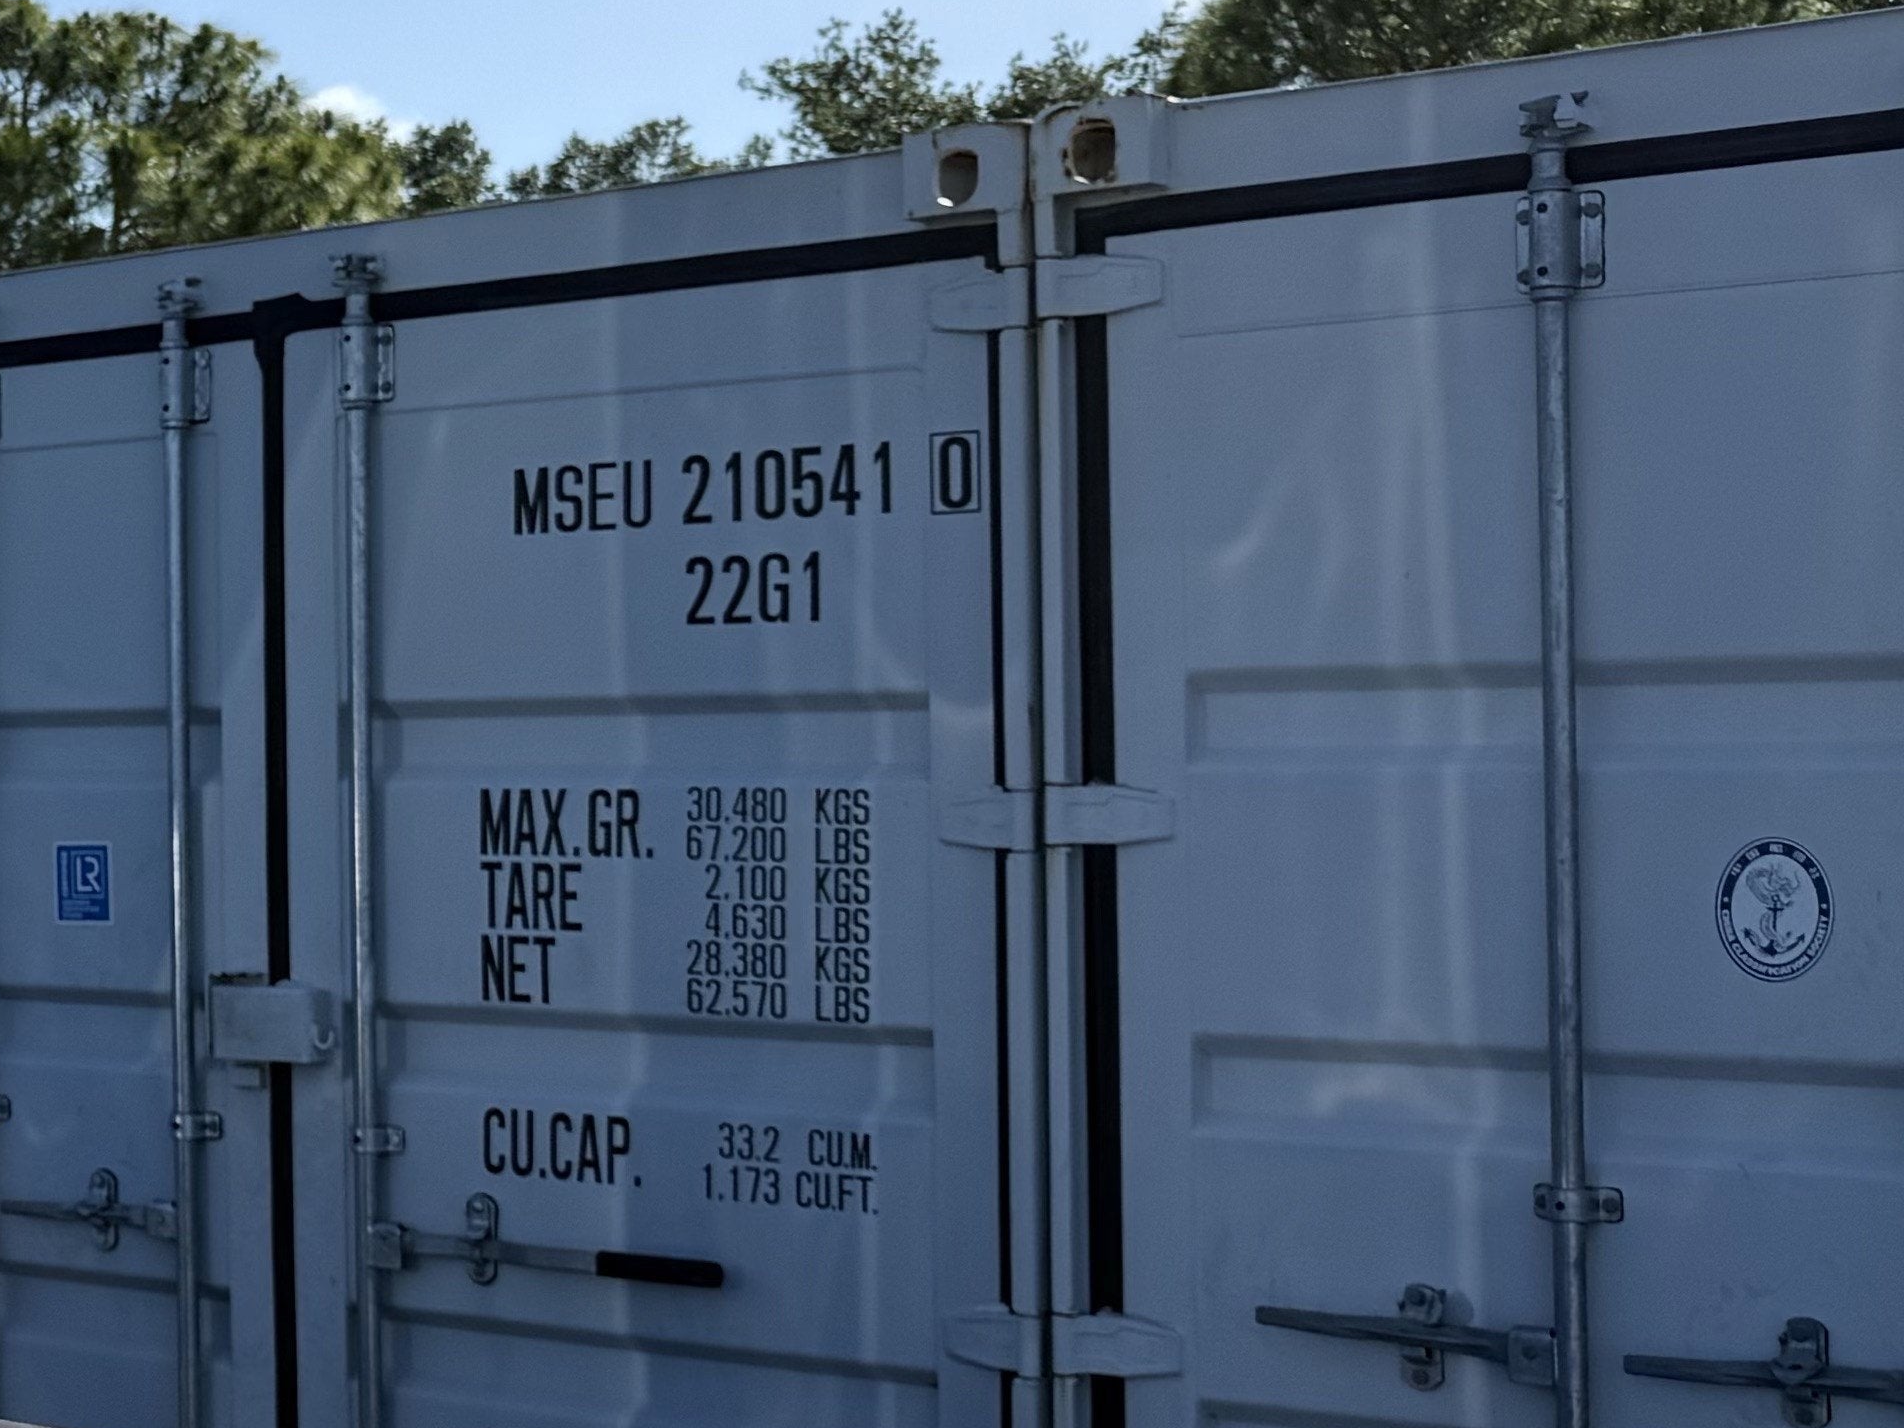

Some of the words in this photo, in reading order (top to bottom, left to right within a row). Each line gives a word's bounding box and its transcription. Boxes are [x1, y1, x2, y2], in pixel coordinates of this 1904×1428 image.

[513, 458, 652, 536] MSEU
[681, 440, 892, 526] 210541
[936, 433, 976, 511] 0
[685, 550, 820, 626] 22G1
[686, 785, 787, 824] 30.480
[814, 787, 870, 826] KGS
[686, 824, 787, 863] 67.200
[814, 827, 870, 866] LBS
[479, 862, 583, 933] TARE
[704, 864, 787, 903] 2.100
[814, 866, 871, 906] KGS
[704, 902, 787, 943] 4.630
[814, 906, 870, 945] LBS
[480, 934, 556, 1005] NET
[686, 941, 787, 981] 28.380
[814, 945, 870, 985] KGS
[686, 979, 787, 1021] 62.570
[814, 984, 870, 1025] LBS
[718, 1121, 780, 1164] 33.2
[702, 1164, 781, 1206] 1.173
